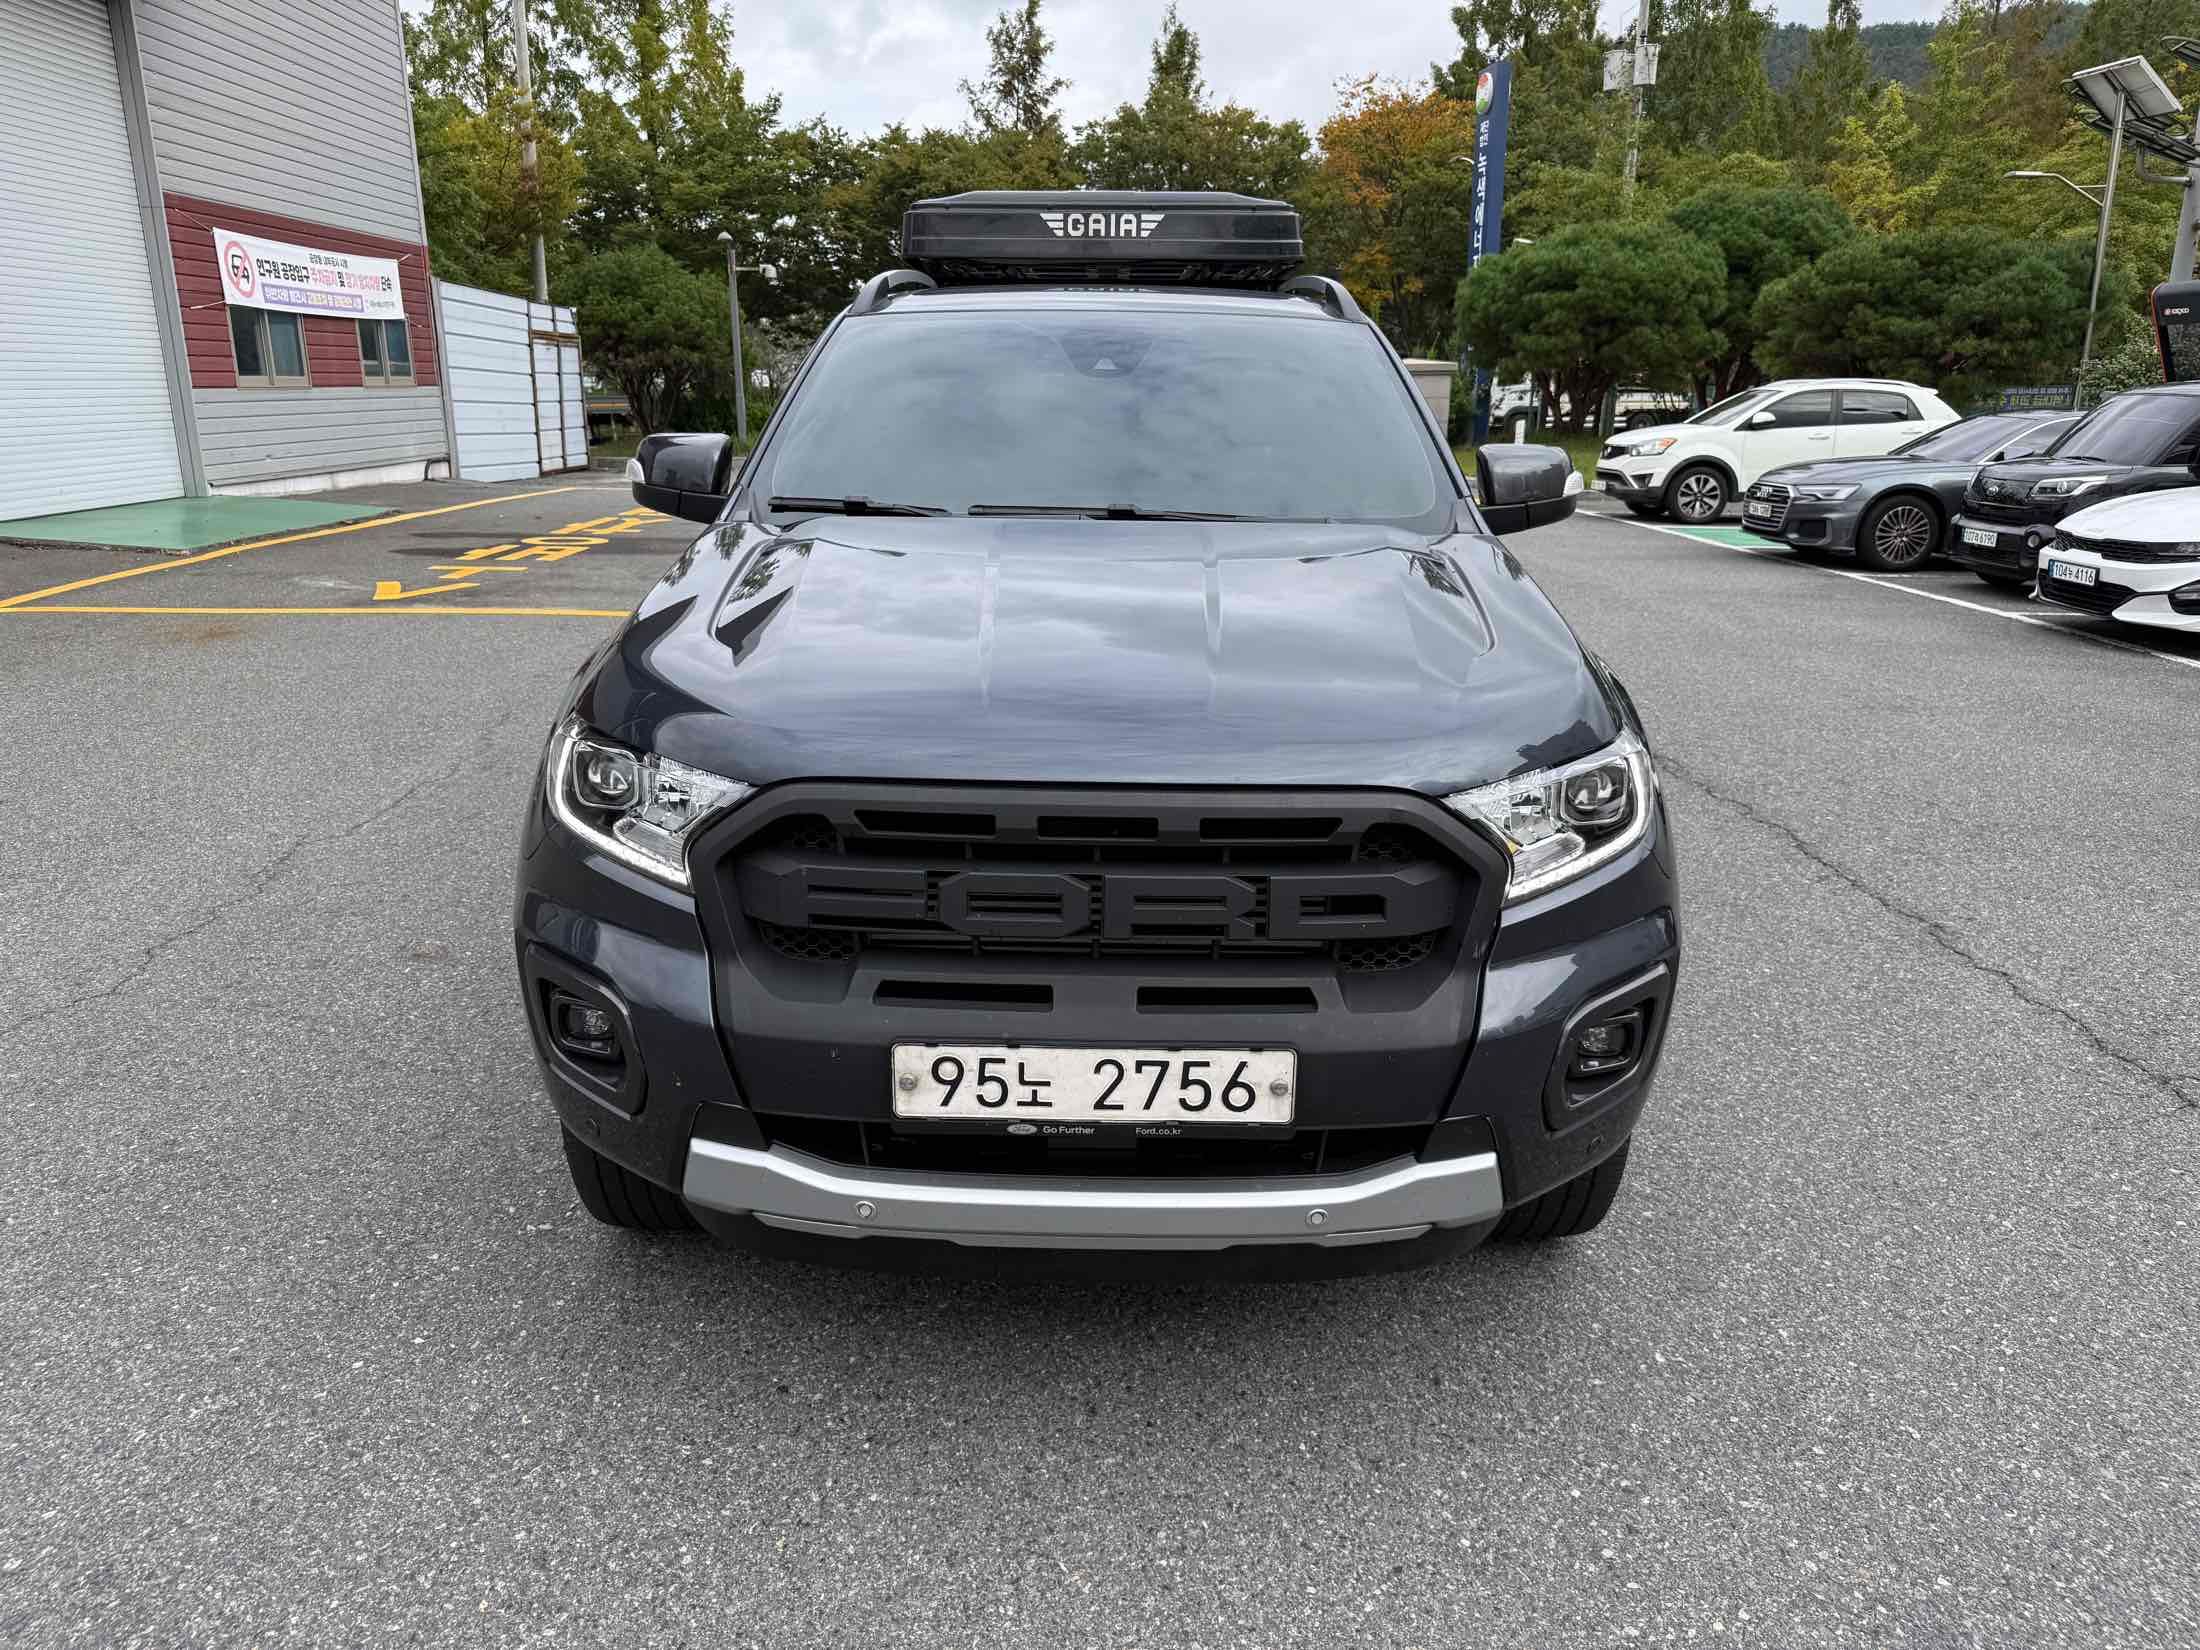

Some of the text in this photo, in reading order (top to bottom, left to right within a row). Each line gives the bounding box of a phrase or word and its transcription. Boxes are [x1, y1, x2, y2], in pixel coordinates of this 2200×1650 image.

[1066, 212, 1138, 237] GAIA
[256, 258, 280, 279] 연구원
[280, 262, 310, 284] 공장입구
[2075, 568, 2094, 583] 4116
[930, 1055, 1257, 1113] 95노 2756
[1043, 1126, 1058, 1135] Go
[1059, 1126, 1096, 1135] Further
[1135, 1127, 1181, 1136] Ford.co.kr
